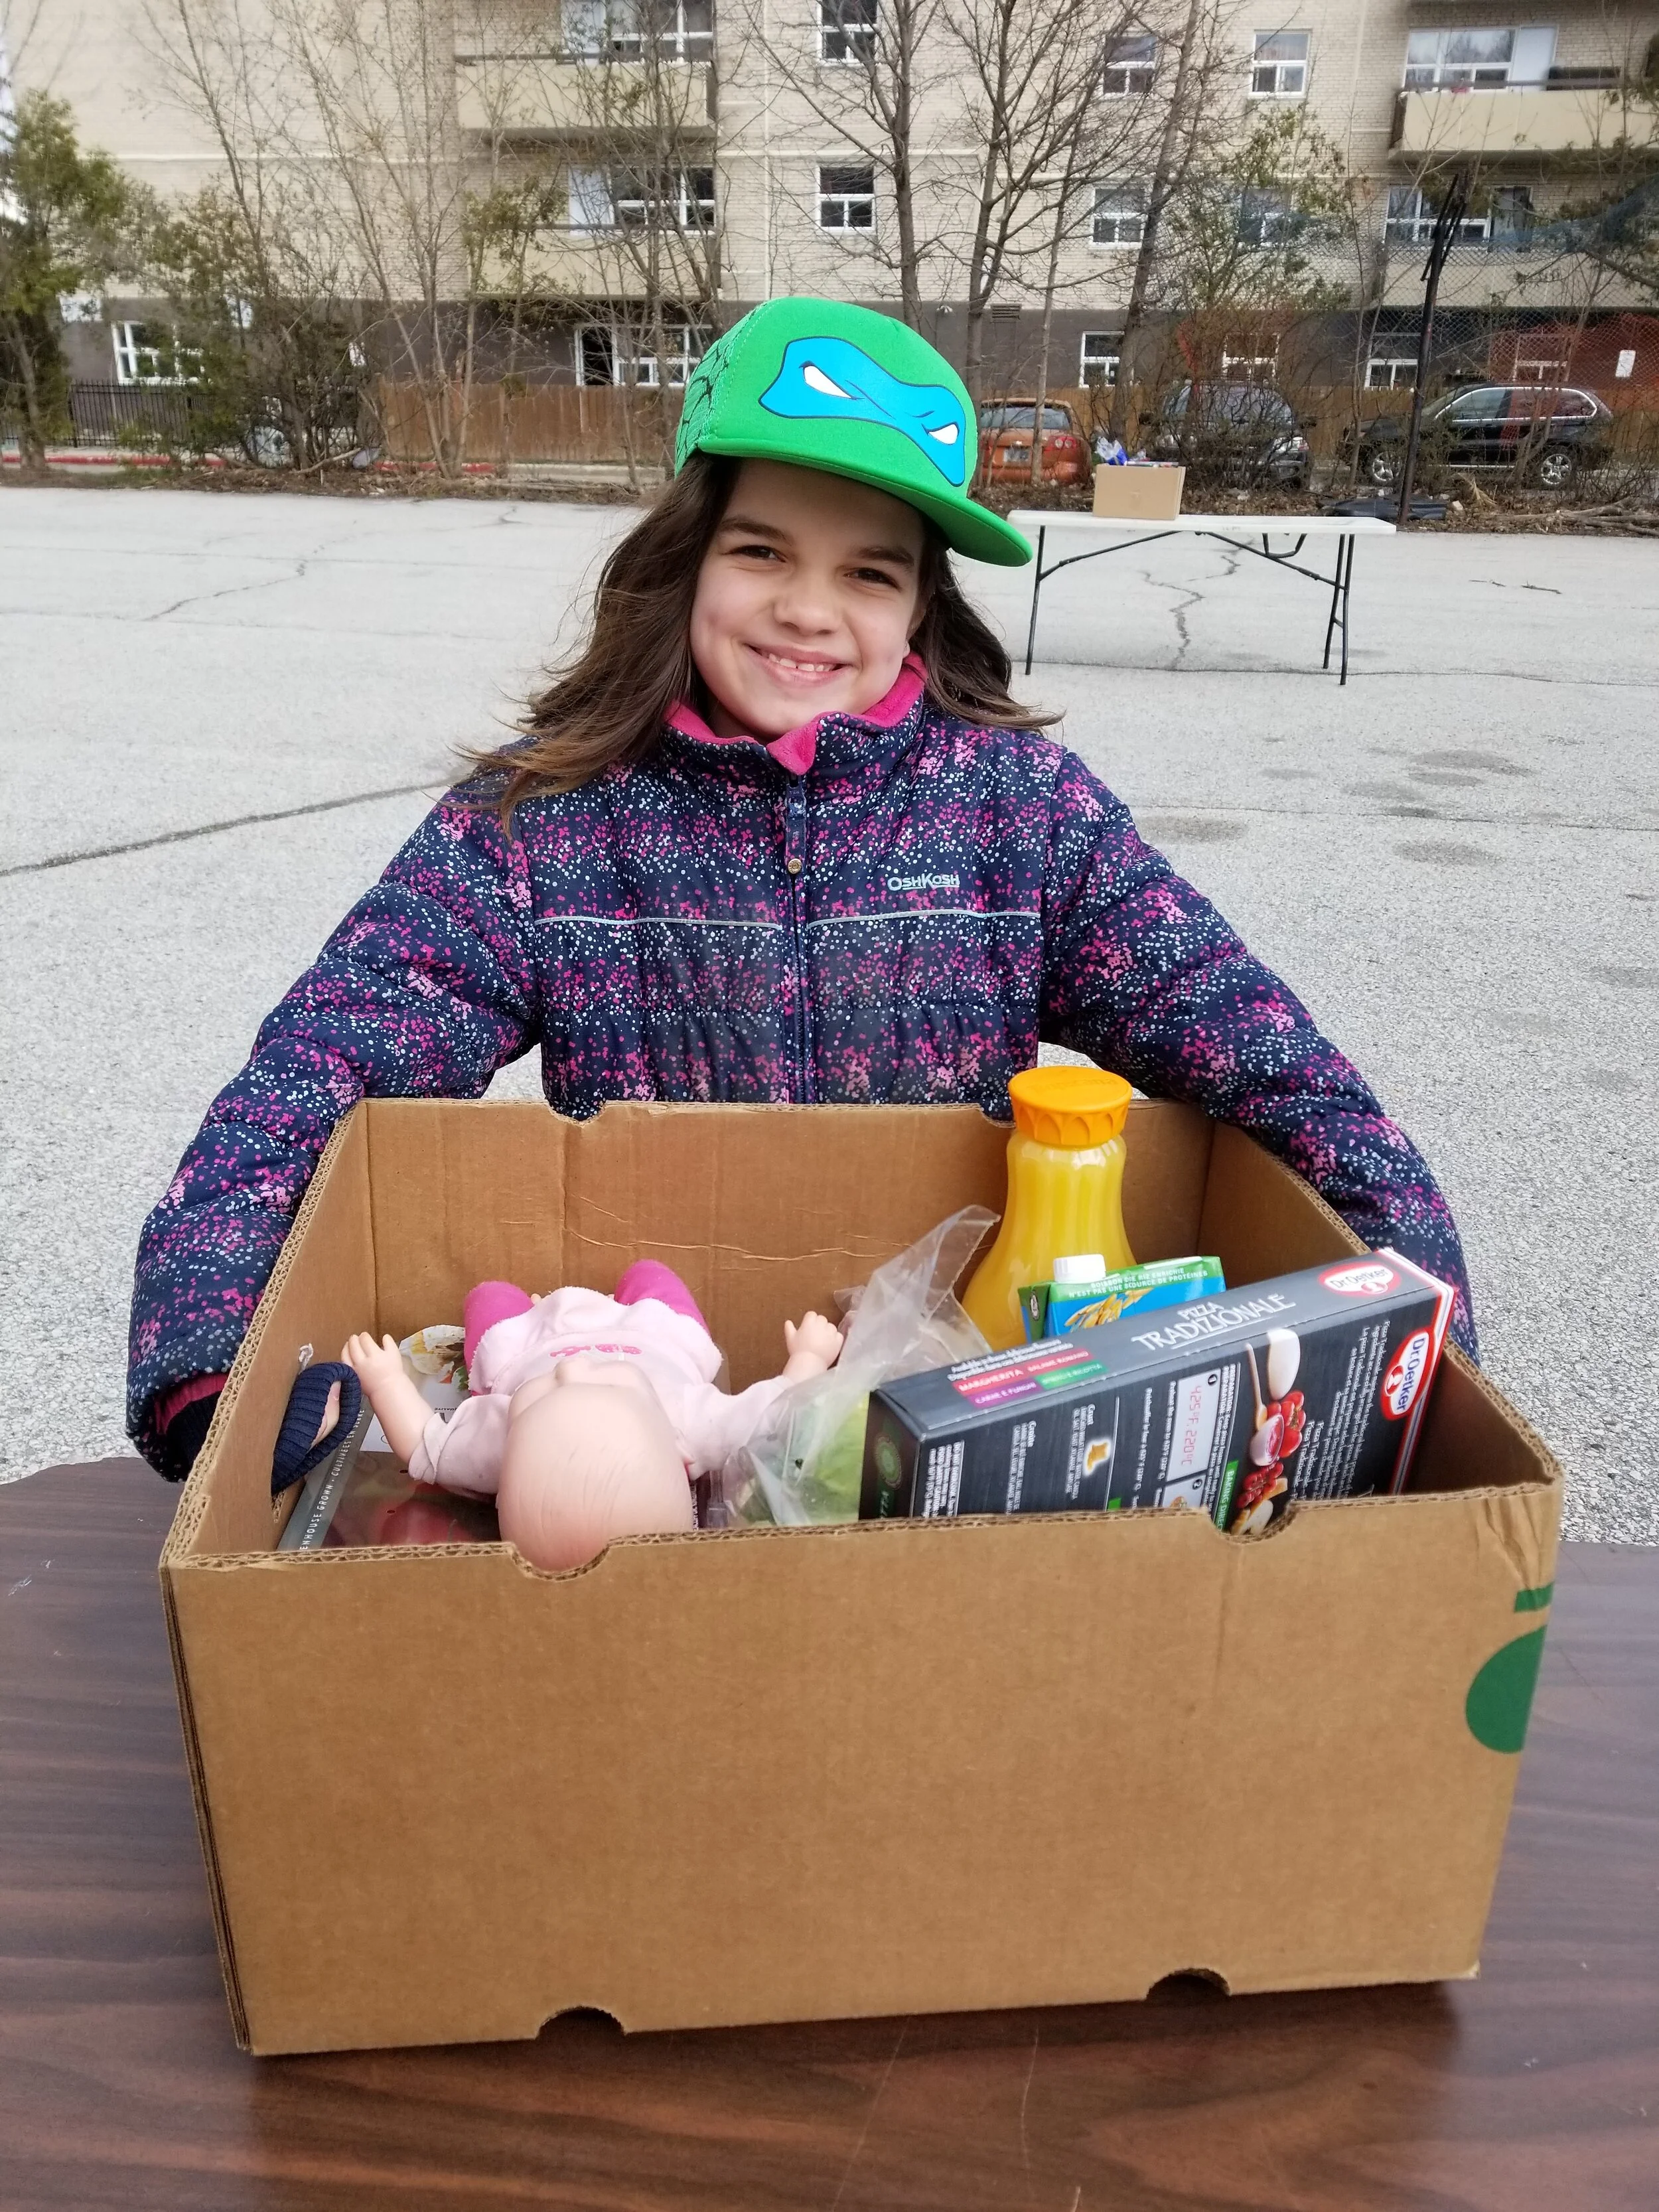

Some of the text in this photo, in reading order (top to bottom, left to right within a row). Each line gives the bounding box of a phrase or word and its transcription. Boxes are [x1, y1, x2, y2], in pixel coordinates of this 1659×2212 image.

[1091, 1276, 1123, 1288] BOISSON
[1152, 1268, 1184, 1278] ENRICHIE
[1169, 1270, 1208, 1282] PROTÉINES
[1178, 1301, 1224, 1321] PIZZA
[1131, 1293, 1296, 1351] TRADIZIONALE
[1363, 1327, 1370, 1336] La
[1382, 1320, 1390, 1337] Pizza
[1358, 1336, 1368, 1354] pizza
[1370, 1324, 1383, 1353] ingredients
[1374, 1337, 1388, 1375] Tradizionale
[1348, 1355, 1357, 1379] texture
[1353, 1353, 1366, 1391] Tradizionale
[958, 1368, 1024, 1392] MARGHERITA
[1225, 1364, 1236, 1414] PREPARATION:
[1359, 1363, 1375, 1398] carefully
[1330, 1390, 1342, 1426] directement
[1352, 1397, 1367, 1425] arranged
[1220, 1414, 1230, 1431] Keep
[1305, 1420, 1315, 1441] Pizza
[1313, 1422, 1325, 1442] Pizza
[1357, 1413, 1370, 1443] traditional
[1218, 1430, 1227, 1446] pizza
[1321, 1437, 1333, 1457] pierre
[1340, 1430, 1349, 1445] selon
[1208, 1451, 1218, 1467] pizza
[1216, 1445, 1225, 1465] frozen
[1353, 1443, 1362, 1460] Italian
[1294, 1440, 1311, 1487] Tradizionale
[1303, 1441, 1321, 1487] Tradizionale
[1319, 1455, 1329, 1475] chaude
[1342, 1463, 1351, 1479] which
[1345, 1460, 1358, 1484] practice
[1209, 1479, 1219, 1495] ready
[1312, 1477, 1322, 1491] pour
[299, 1514, 321, 1550] ENHOUSE
[317, 1483, 334, 1511] GROWN
[332, 1439, 352, 1477] CULTIVÉES
[1216, 1470, 1234, 1531] BAKING DIREC
